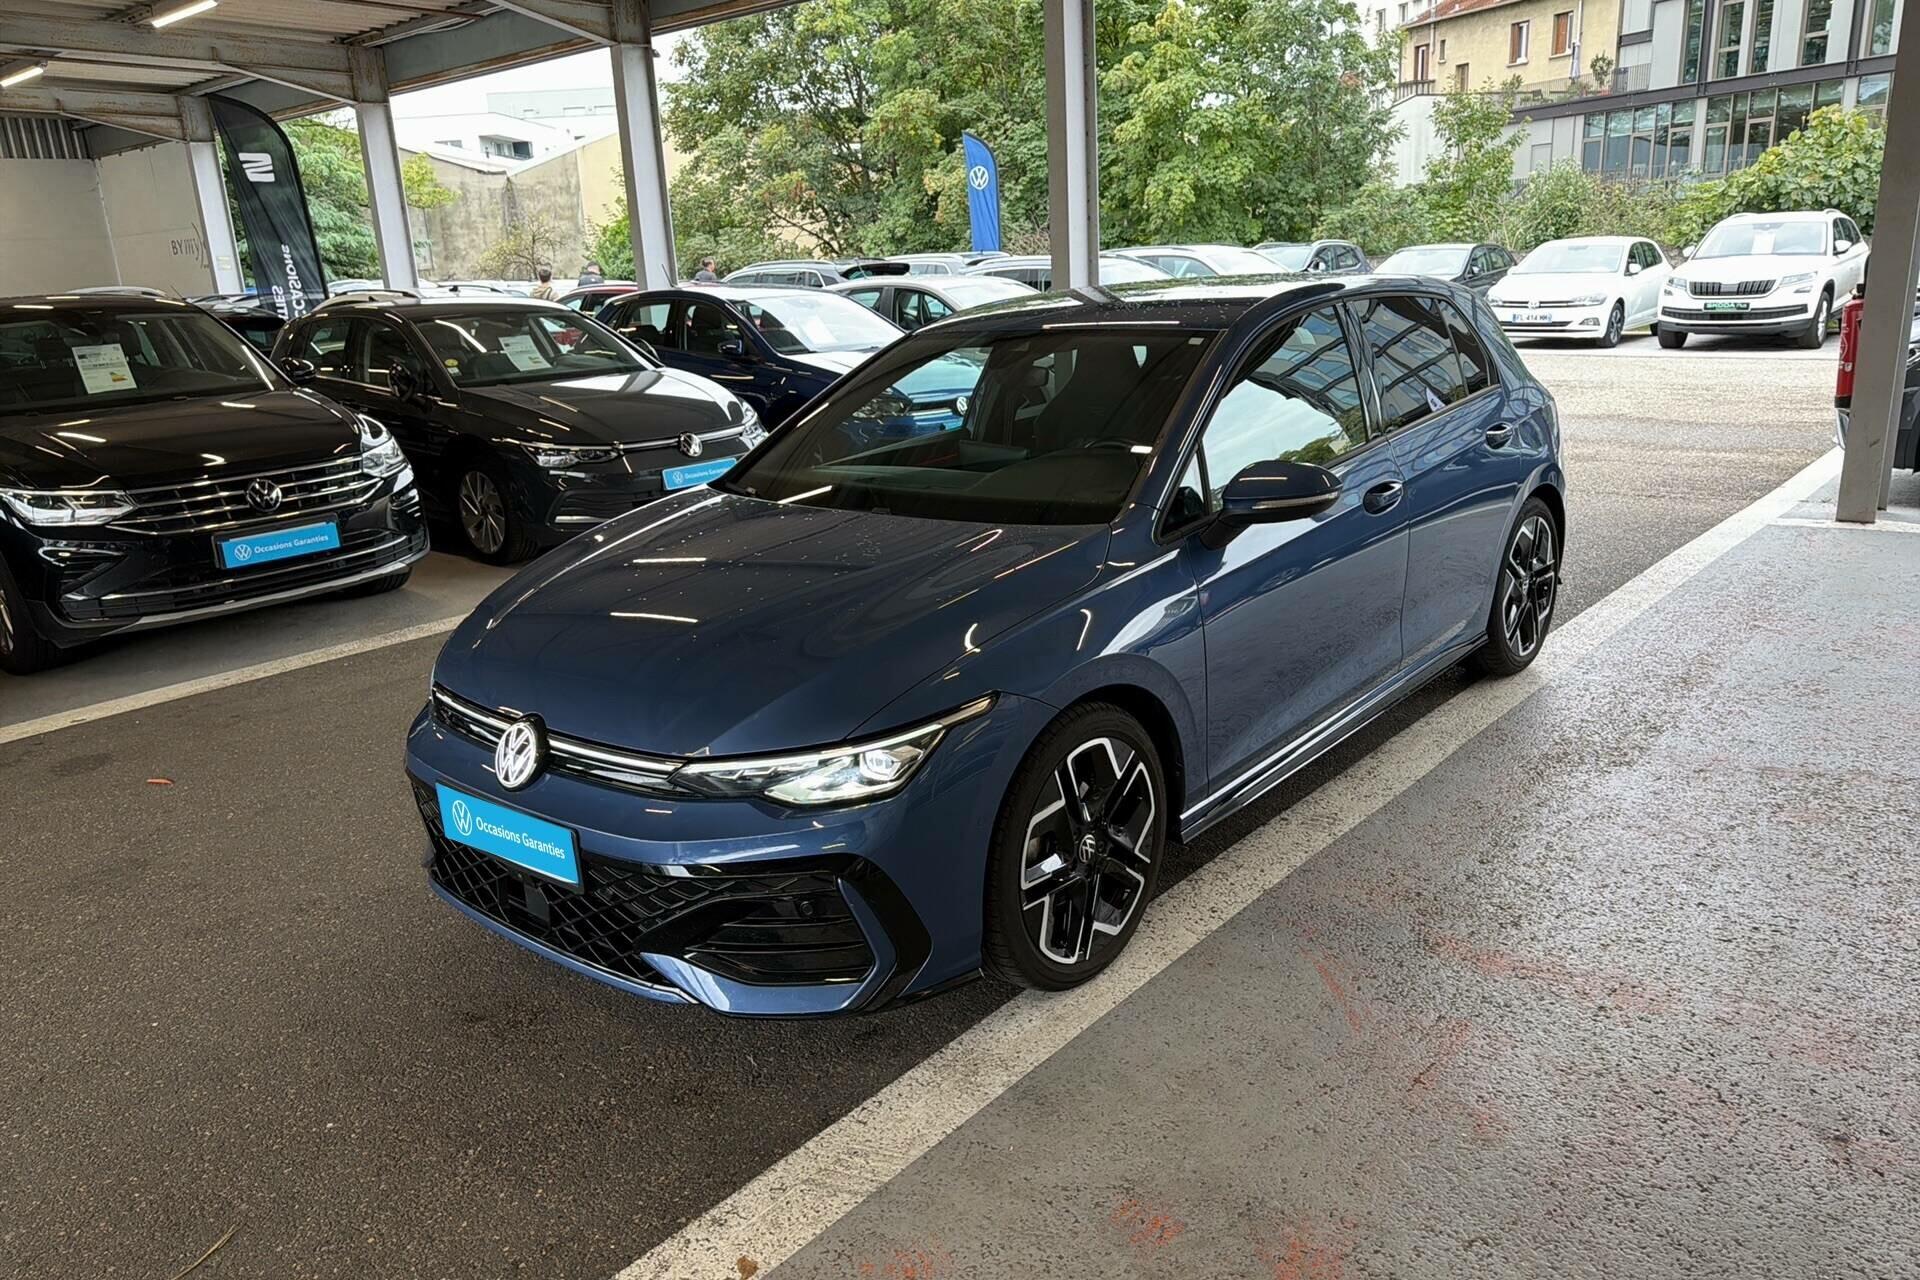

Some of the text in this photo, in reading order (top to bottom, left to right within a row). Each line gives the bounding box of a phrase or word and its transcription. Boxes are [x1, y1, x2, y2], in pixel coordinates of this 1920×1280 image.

[254, 541, 293, 554] Occasions
[293, 534, 329, 546] Garanties
[475, 816, 521, 844] Occasions
[522, 833, 566, 860] Garanties
